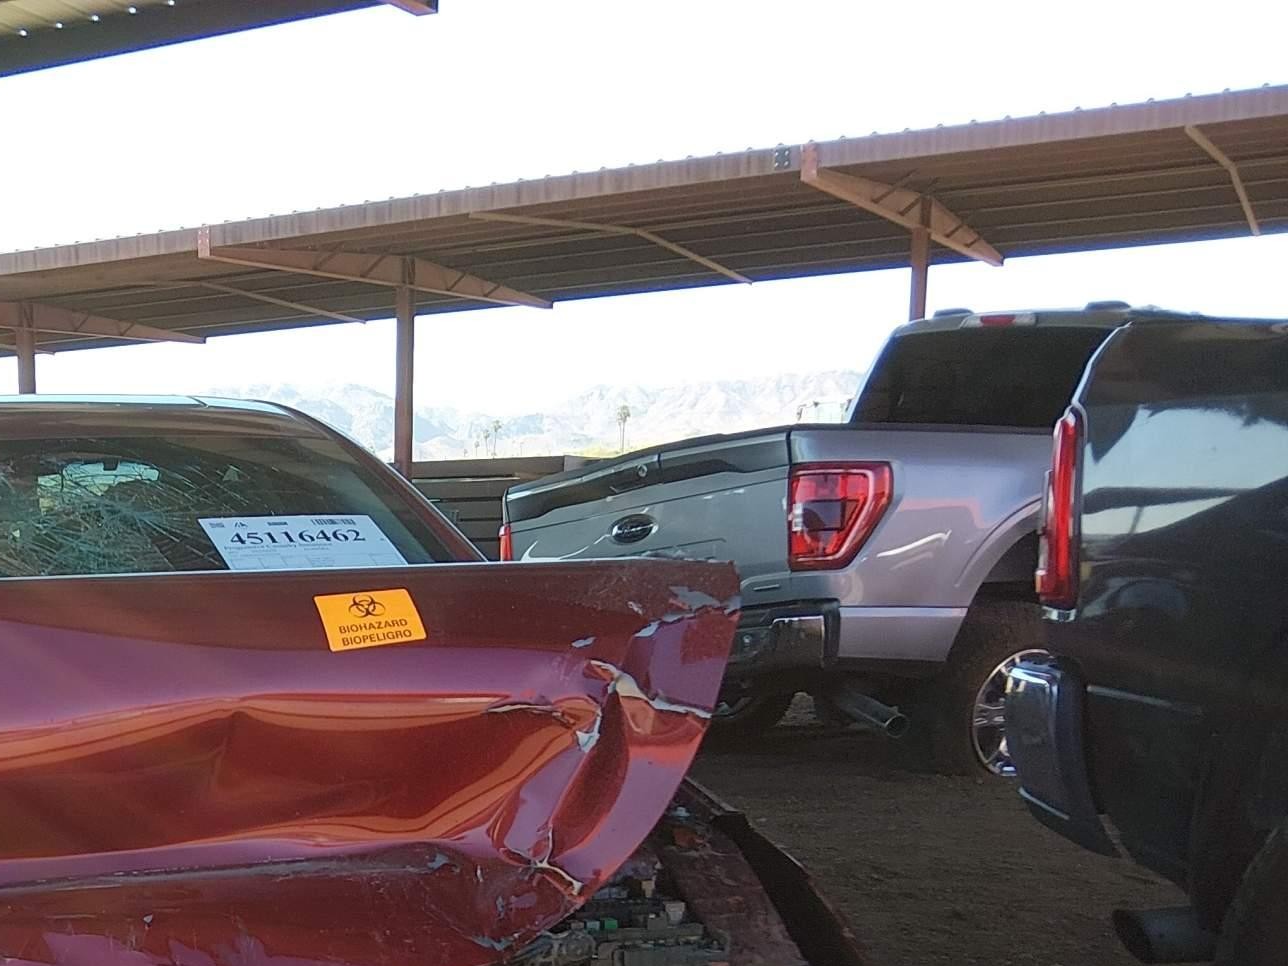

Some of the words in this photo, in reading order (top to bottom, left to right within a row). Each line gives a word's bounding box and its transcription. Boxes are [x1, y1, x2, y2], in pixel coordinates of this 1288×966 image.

[230, 528, 366, 545] 45116462
[338, 618, 408, 634] BIOHAZARD
[341, 629, 413, 647] BIOPELIGRO
